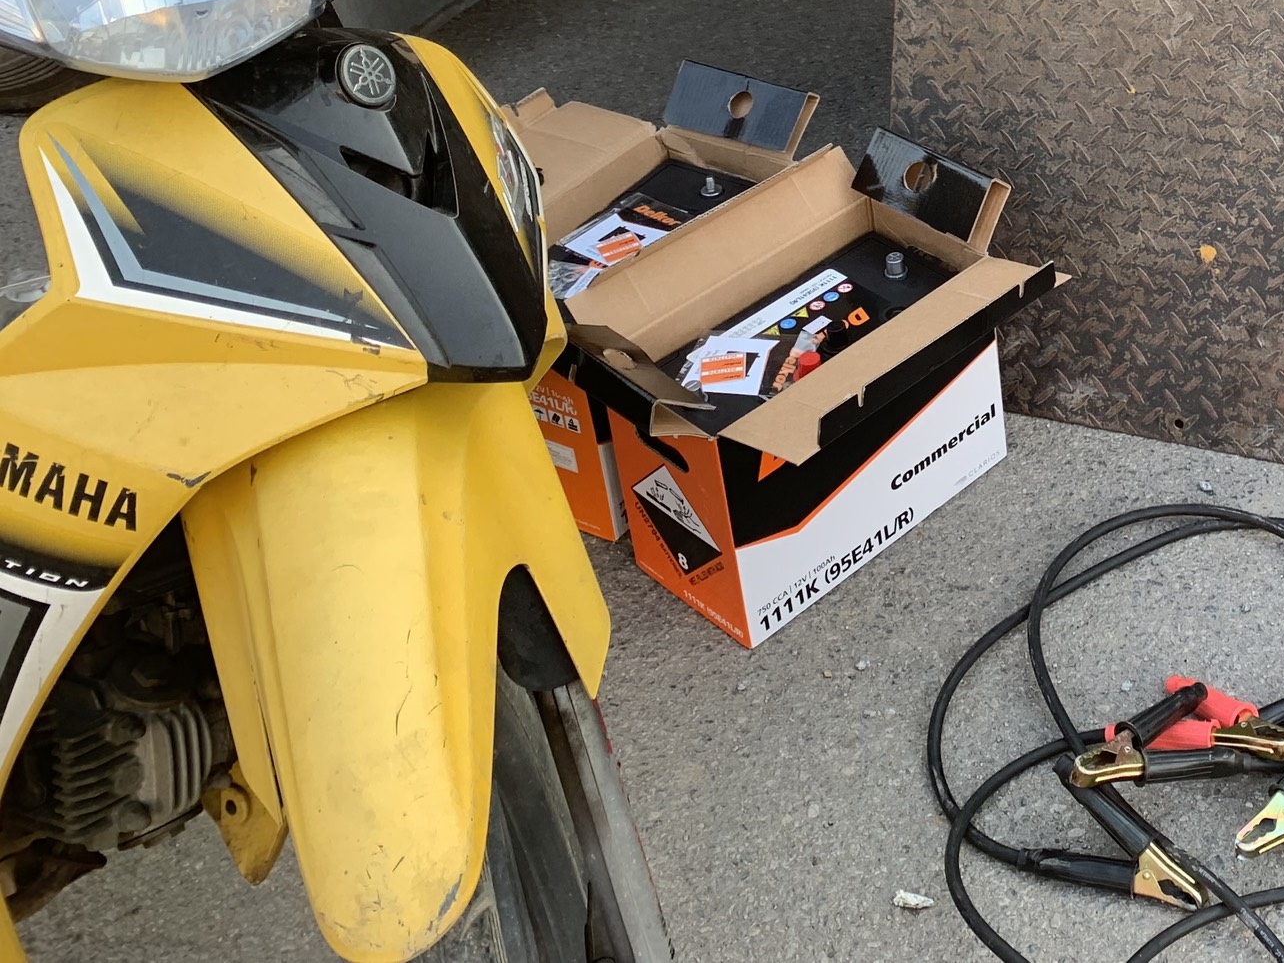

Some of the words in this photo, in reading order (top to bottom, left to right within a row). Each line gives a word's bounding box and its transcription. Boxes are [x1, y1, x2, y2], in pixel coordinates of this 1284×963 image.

[633, 204, 682, 226] Delkor
[891, 403, 996, 490] Commercial
[968, 451, 1000, 477] CLARIOS
[635, 501, 660, 542] UN2794
[677, 552, 688, 570] 8
[760, 577, 820, 631] 1111K
[825, 507, 914, 584] (95E41L/R)
[757, 603, 771, 616] 750
[773, 590, 788, 605] CCA
[794, 575, 807, 588] 12V
[813, 555, 836, 575] 100Ah
